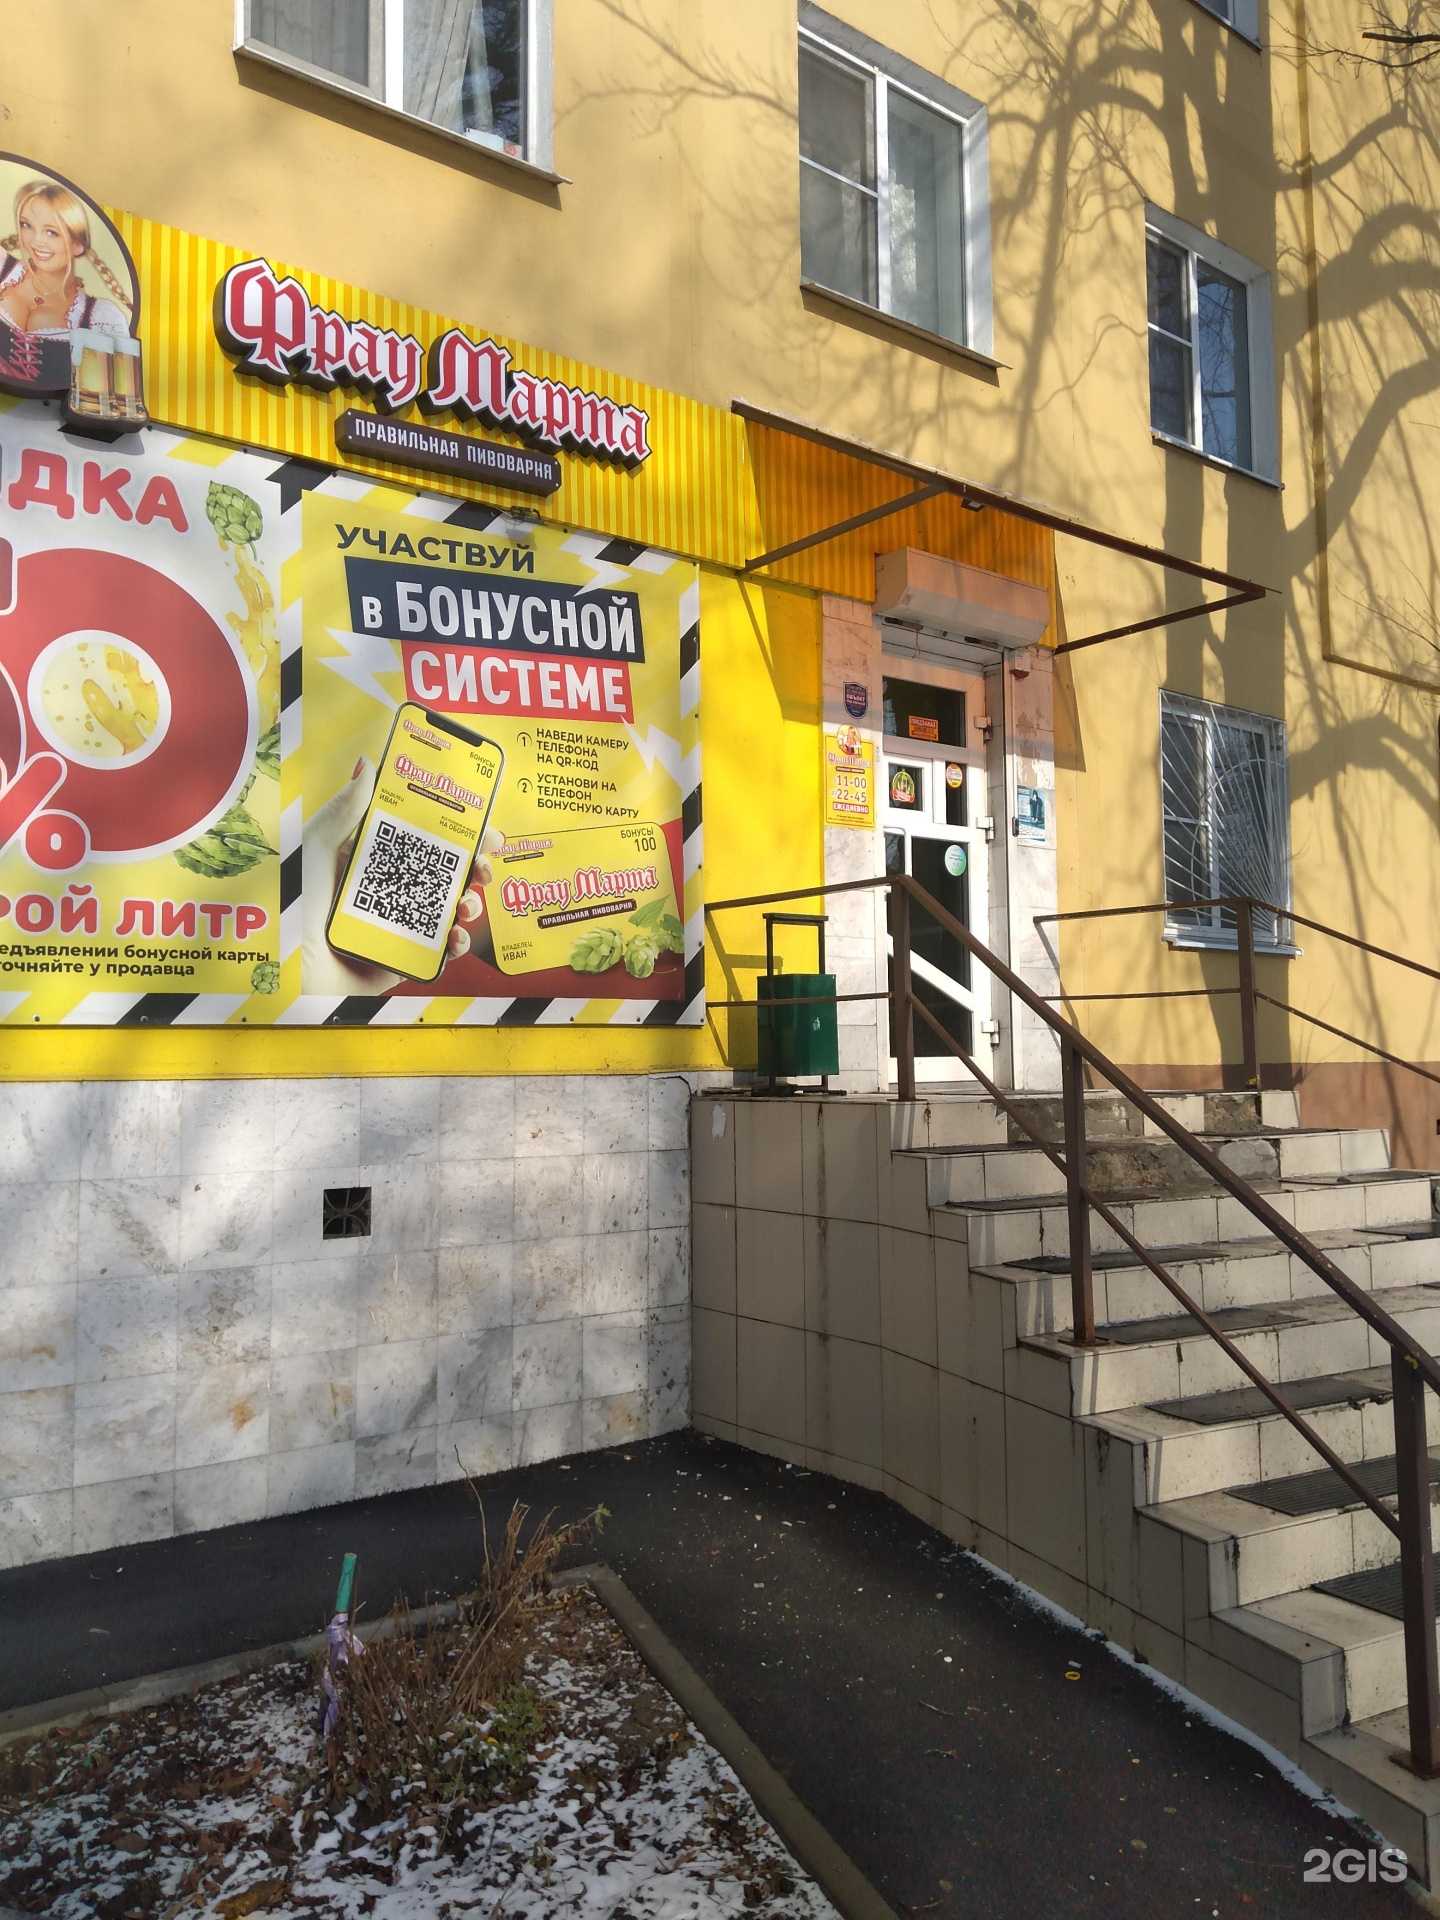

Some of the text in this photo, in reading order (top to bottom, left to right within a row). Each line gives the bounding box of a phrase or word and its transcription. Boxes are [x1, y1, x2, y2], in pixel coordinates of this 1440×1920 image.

[227, 260, 648, 460] Фрау Марта
[355, 418, 552, 481] ПРАВИЛЬНАЯ ПИВОВАРНЯ
[0, 443, 189, 533] ДКА
[335, 524, 534, 573] УЧАСТВУЙ
[395, 581, 636, 653] БОНУСНОЙ
[410, 651, 626, 713] СИСТЕМЕ
[536, 728, 583, 744] НАВЕДИ
[586, 736, 629, 750] КАМЕРУ
[537, 740, 598, 758] ТЕЛЕФОНА
[475, 763, 493, 779] 100
[537, 753, 599, 771] НА QR-КОД
[537, 773, 598, 790] УСТАНОВИ
[602, 782, 617, 792] НА
[537, 785, 592, 801] ТЕЛЕФОН
[537, 798, 639, 818] БОНУСНУЮ КАРТУ
[620, 827, 654, 839] БОНУСЫ
[634, 837, 656, 852] 100
[503, 866, 659, 917] Фрау Марта
[116, 900, 267, 939] ЛИТР
[542, 901, 633, 925] ПРАВИЛЬНАЯ ПИВОВАРНЯ
[124, 945, 212, 961] бонусной
[217, 951, 269, 963] карты
[503, 950, 527, 961] ИВАН
[0, 959, 195, 976] очняйте у продавца
